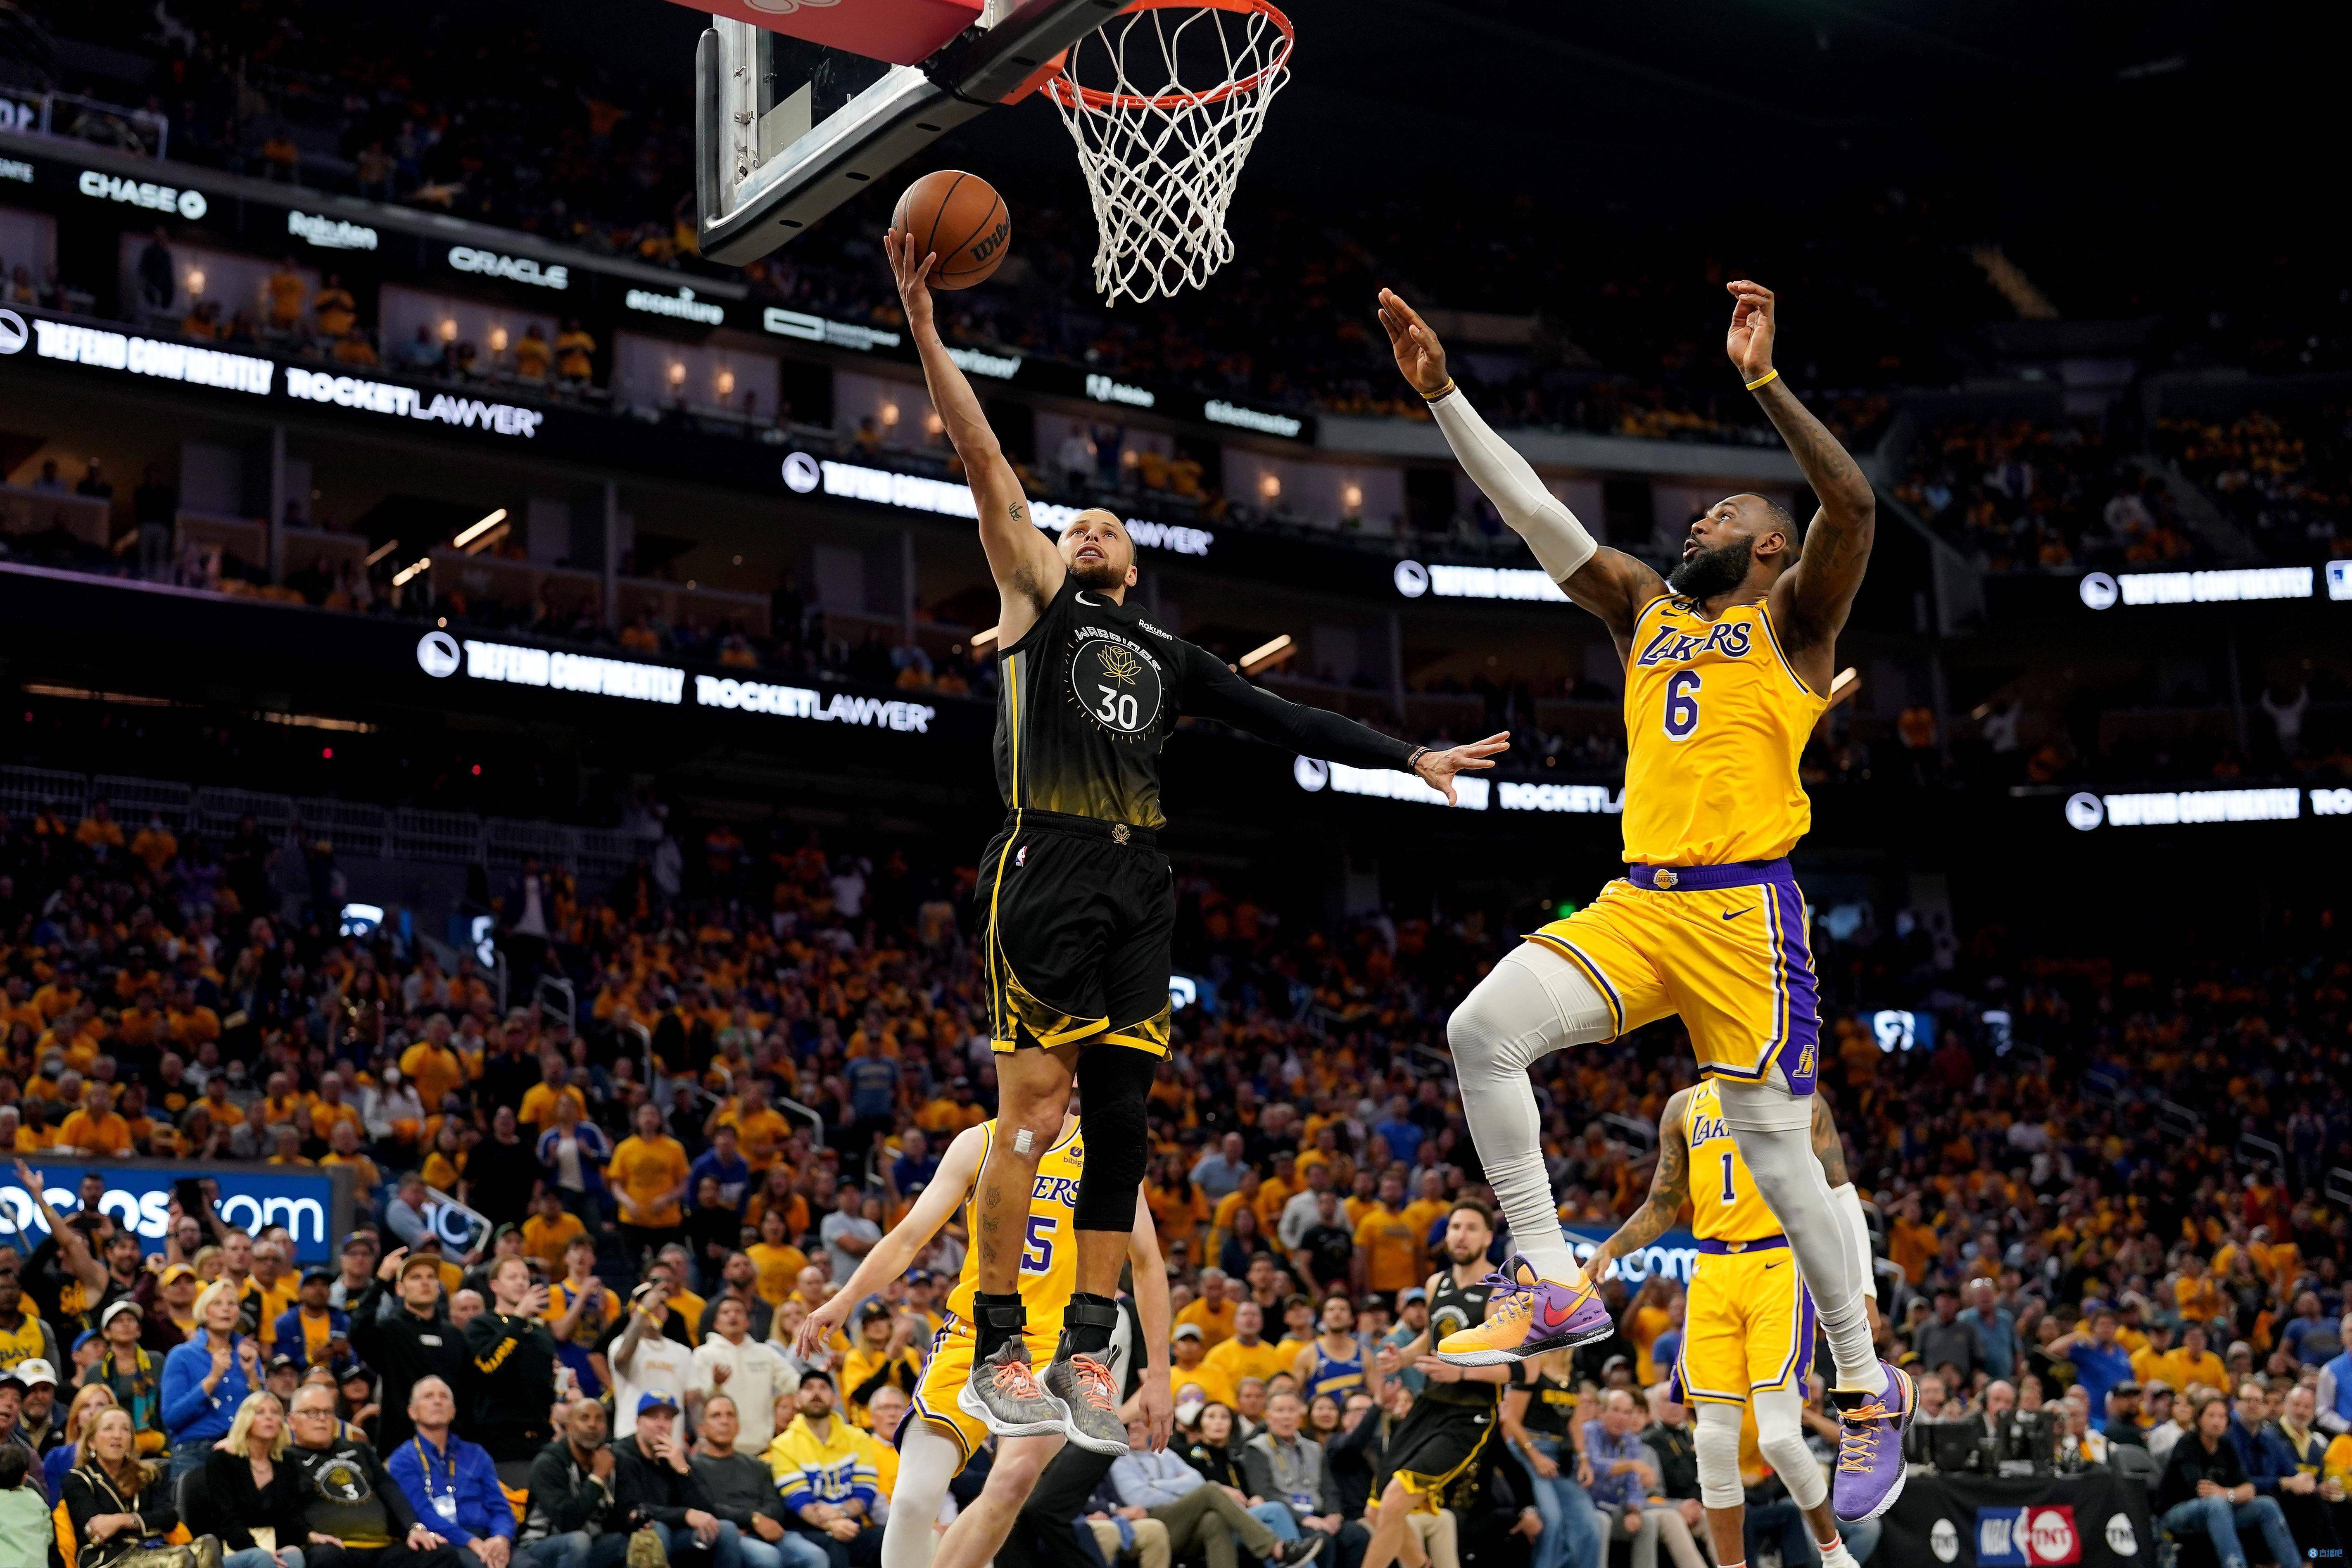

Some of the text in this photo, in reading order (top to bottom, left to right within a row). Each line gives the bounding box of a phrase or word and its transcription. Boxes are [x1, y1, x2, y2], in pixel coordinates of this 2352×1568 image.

[79, 171, 178, 214] CHASE
[449, 246, 568, 290] ORACLE
[1075, 626, 1162, 671] WARRIORS
[1138, 619, 1172, 641] Rakuten
[1635, 622, 1753, 667] LAKRS
[1096, 684, 1138, 729] 30
[1662, 669, 1702, 742] 6
[1063, 1156, 1084, 1167] bibig
[1720, 1151, 1737, 1205] 1
[1981, 1518, 2011, 1556] NBA
[2031, 1528, 2071, 1546] TNT
